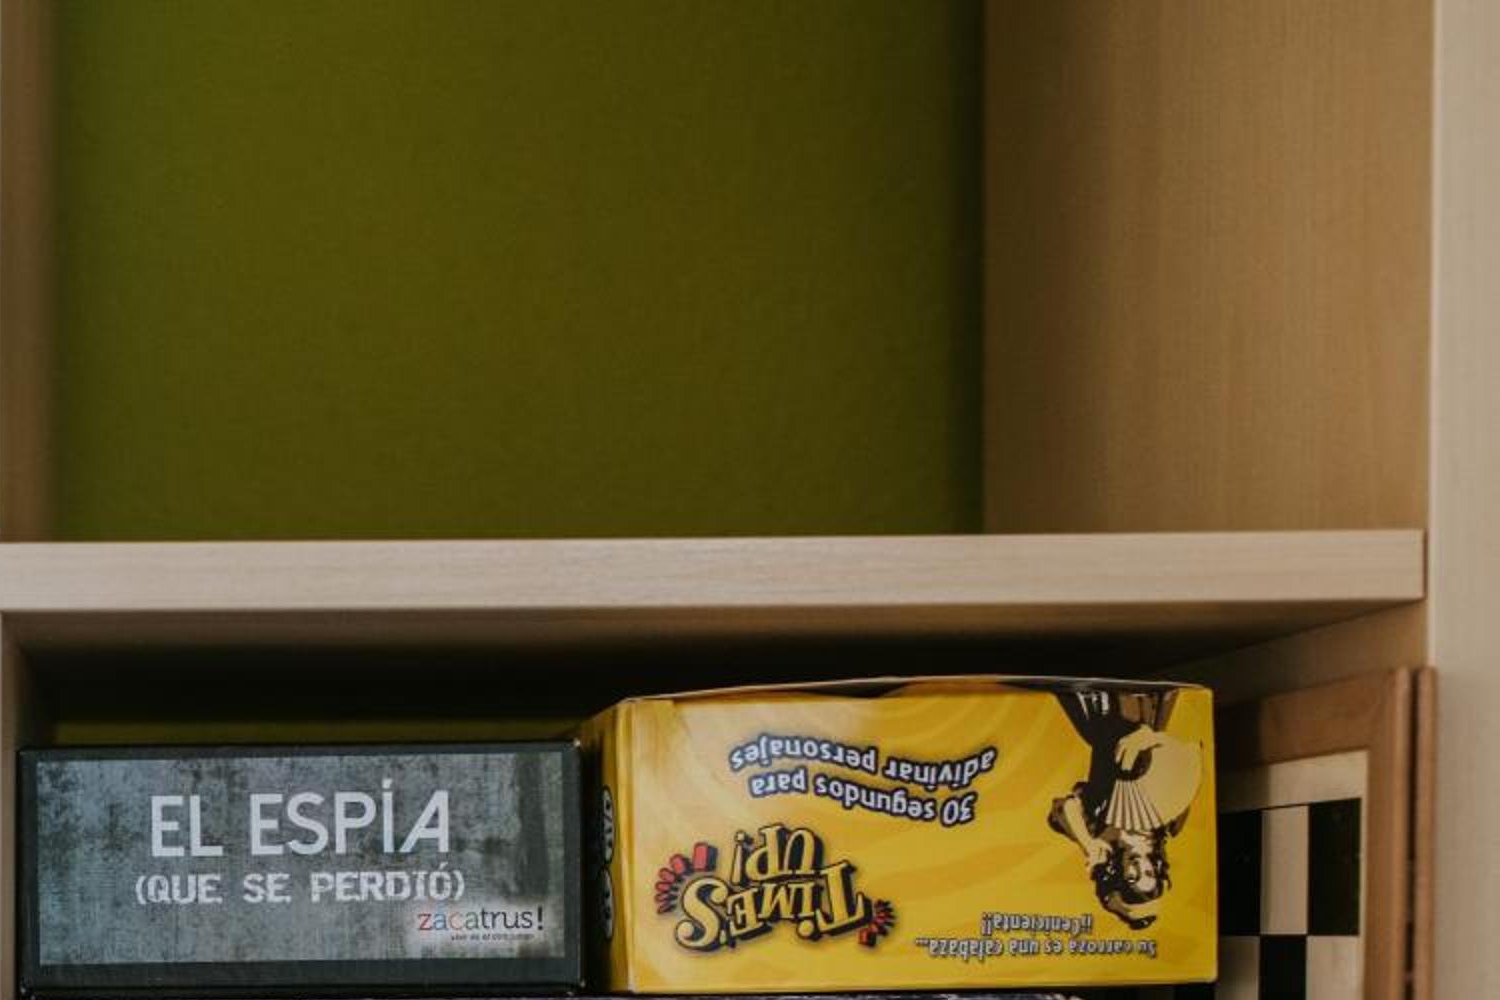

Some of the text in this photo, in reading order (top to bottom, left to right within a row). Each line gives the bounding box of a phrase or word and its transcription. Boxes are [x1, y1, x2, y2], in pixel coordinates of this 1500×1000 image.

[729, 734, 998, 791] adivinar personajes
[151, 779, 450, 857] EL ESPÍA
[749, 768, 977, 828] 30 segundos para
[728, 822, 832, 886] UP!
[134, 863, 466, 905] (QUE SE PERDIÓ)
[417, 905, 544, 931] zacatrus!
[1008, 938, 1040, 955] una
[1043, 938, 1062, 954] es
